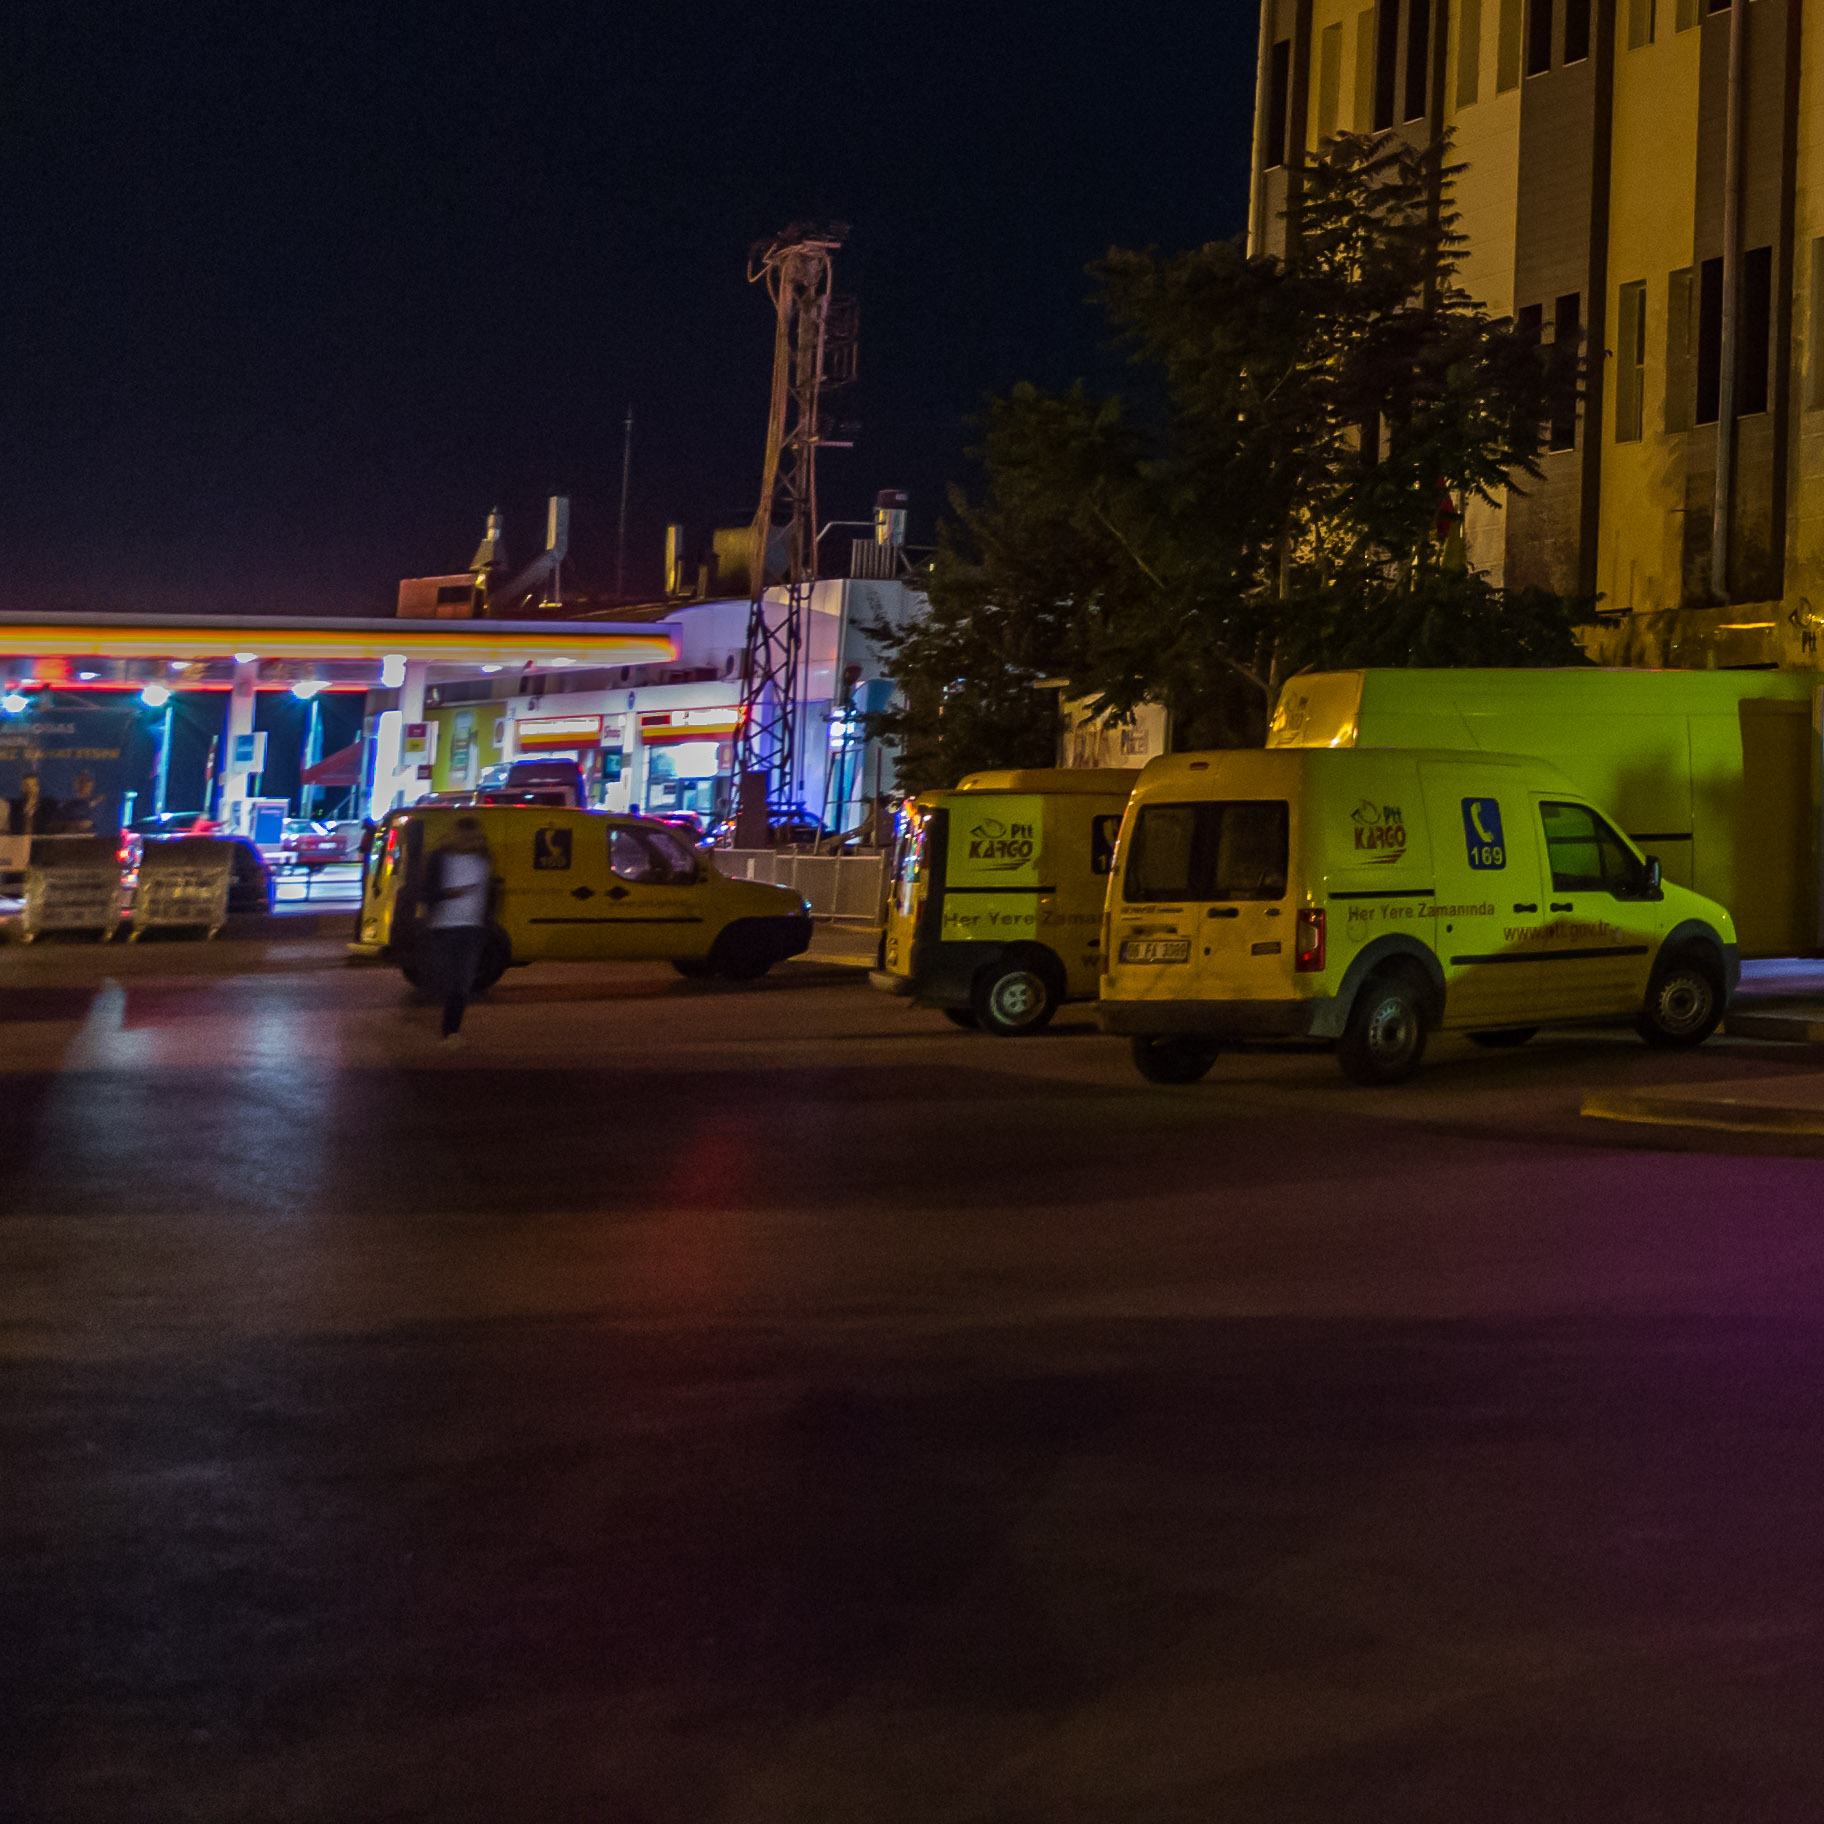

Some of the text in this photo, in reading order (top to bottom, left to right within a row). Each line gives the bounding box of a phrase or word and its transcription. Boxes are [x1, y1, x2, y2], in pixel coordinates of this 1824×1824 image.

[1010, 823, 1034, 839] Ptt
[1354, 826, 1406, 849] KARGO
[968, 840, 1034, 859] KARGO
[1470, 846, 1504, 866] 169
[943, 911, 979, 928] Her
[988, 911, 1035, 927] Yere
[1348, 905, 1374, 921] Her
[1380, 903, 1414, 920] Yere
